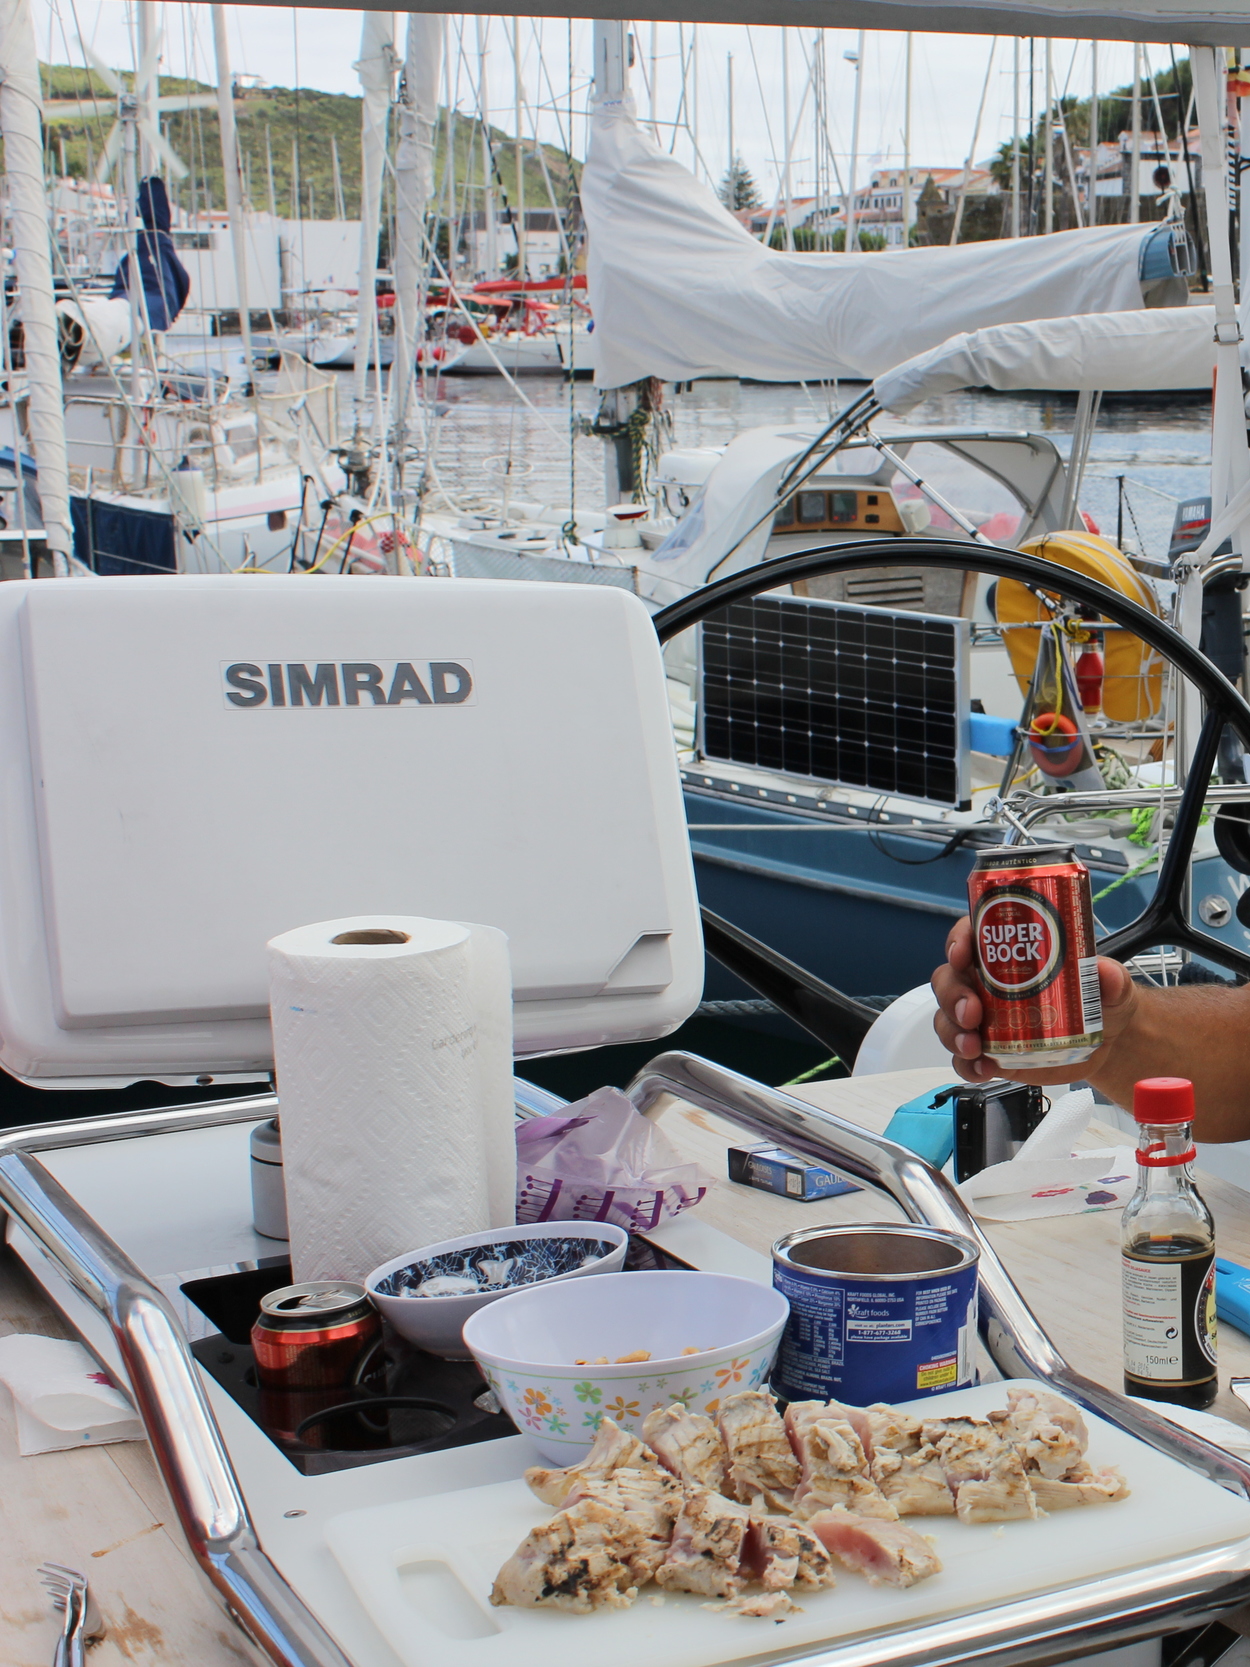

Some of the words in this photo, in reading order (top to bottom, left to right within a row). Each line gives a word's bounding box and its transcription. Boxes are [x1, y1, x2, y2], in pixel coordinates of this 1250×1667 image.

[1182, 504, 1206, 522] YAMAHA
[226, 662, 473, 707] SIMRAD
[982, 923, 1044, 944] SUPER
[986, 942, 1043, 963] BOCK
